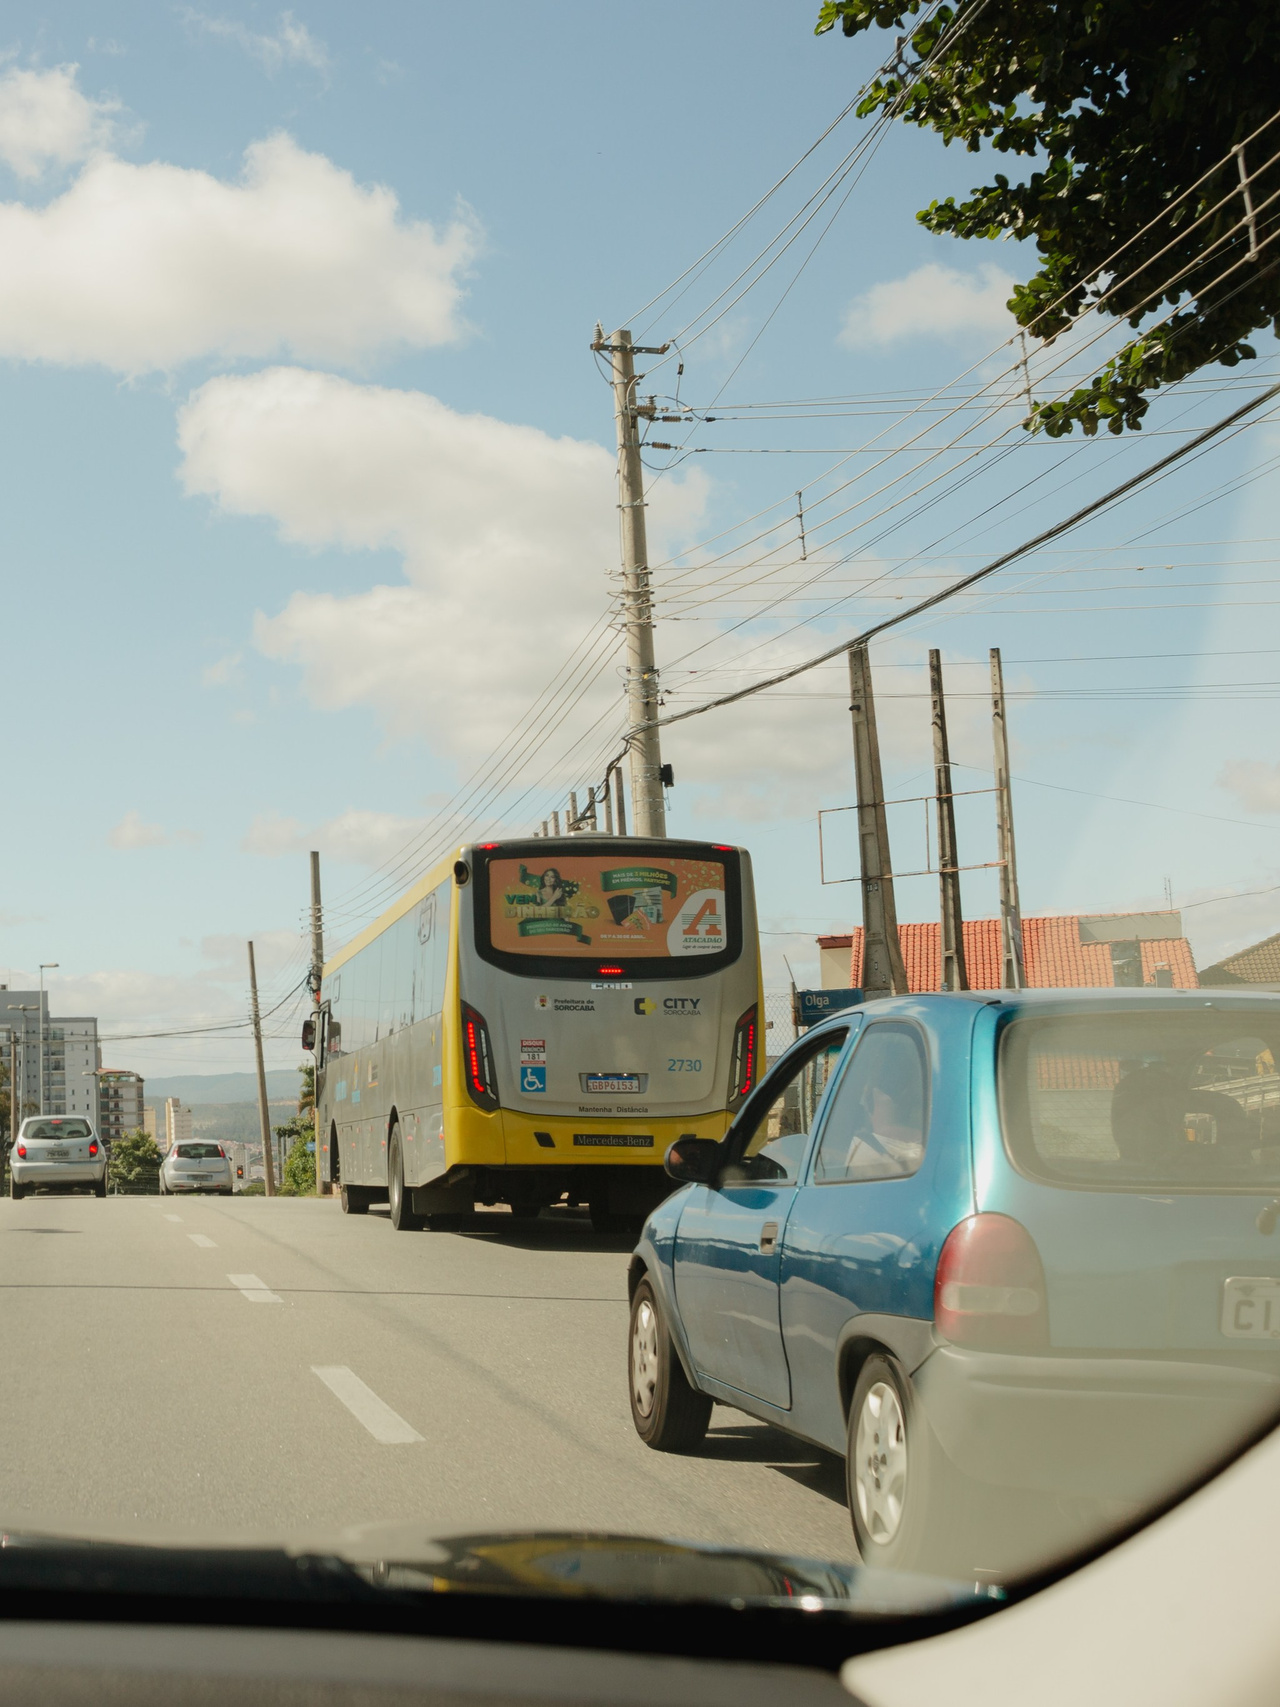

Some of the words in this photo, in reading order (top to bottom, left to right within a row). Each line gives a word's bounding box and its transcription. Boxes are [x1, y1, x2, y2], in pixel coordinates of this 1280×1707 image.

[663, 998, 701, 1009] CITY
[805, 994, 830, 1008] Olga
[667, 1058, 702, 1072] 2730
[592, 1081, 634, 1090] GBP6153
[577, 1135, 651, 1146] Mercedes-Benz
